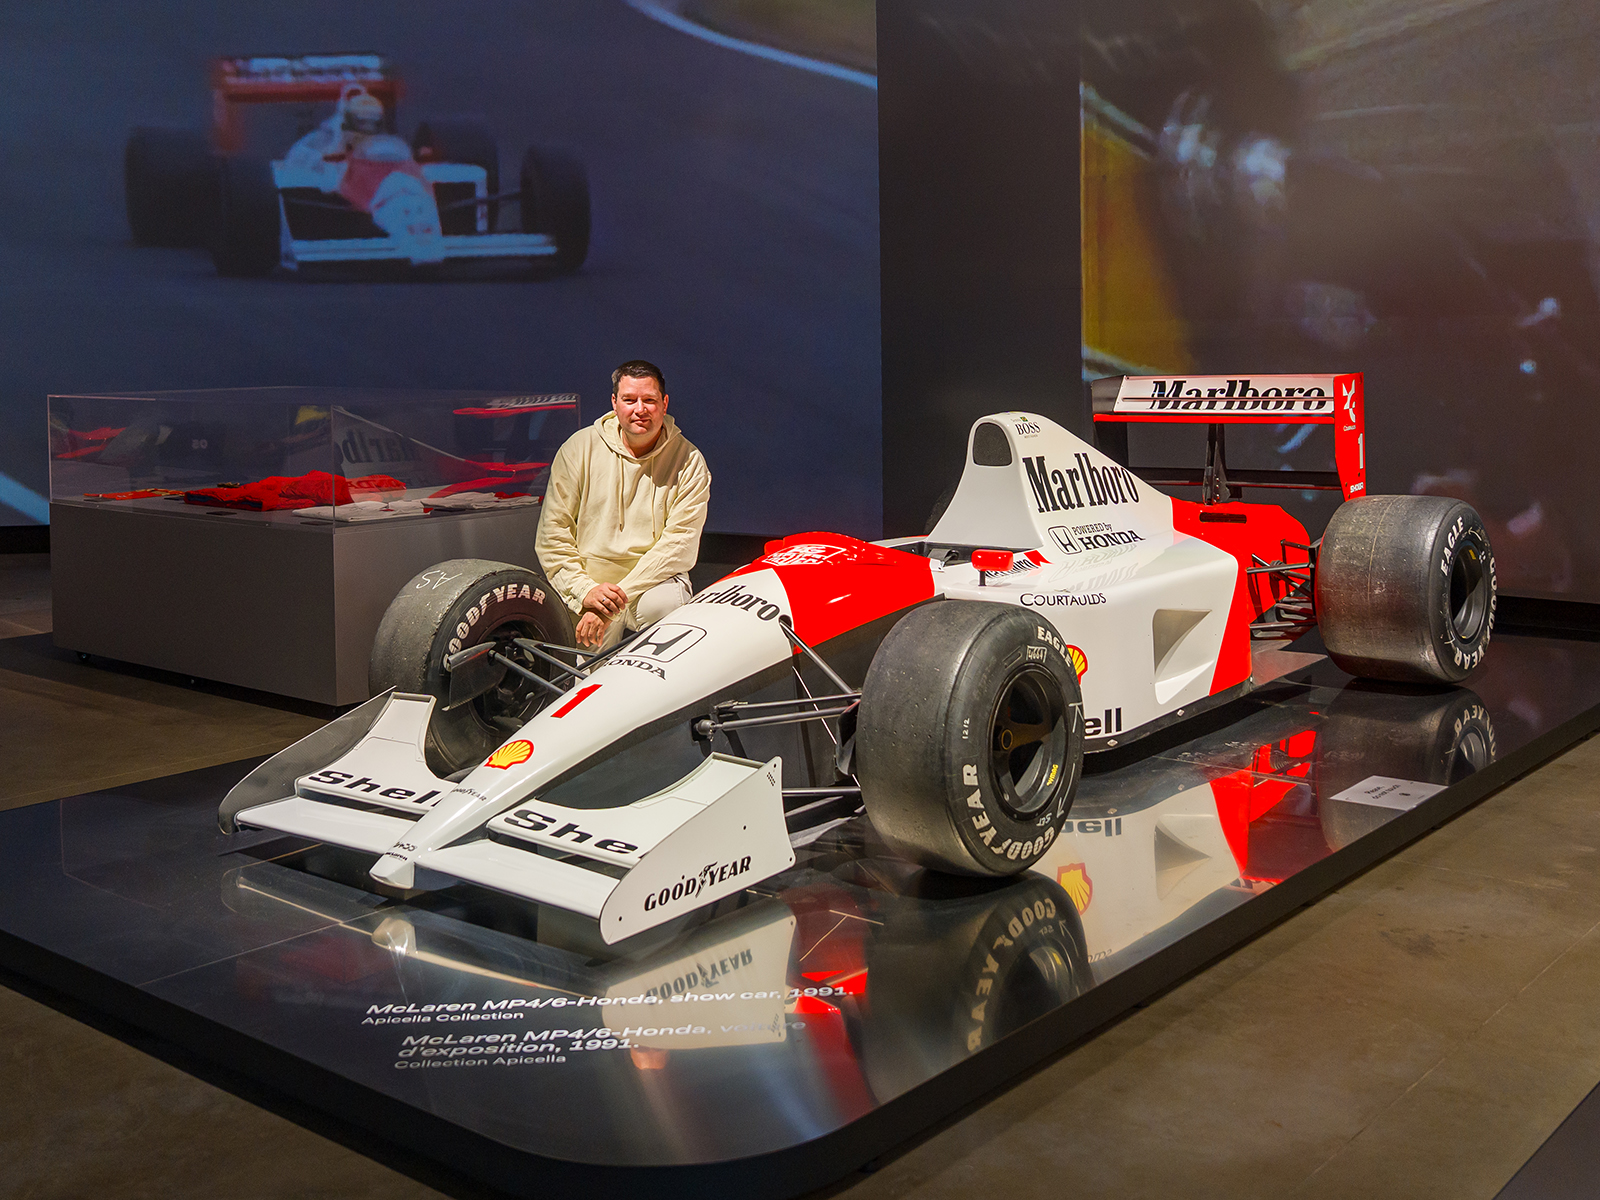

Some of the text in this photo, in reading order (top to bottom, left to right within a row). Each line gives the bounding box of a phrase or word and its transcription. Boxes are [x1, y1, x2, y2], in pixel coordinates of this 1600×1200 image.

[1149, 379, 1327, 411] Marlboro
[1015, 421, 1041, 435] BOSS
[1357, 433, 1364, 469] 1
[1022, 453, 1140, 513] Marlboro
[1072, 522, 1112, 536] POWERED by
[1078, 530, 1146, 551] HONDA
[1440, 516, 1464, 576] EAGLE
[690, 584, 781, 621] arlboro
[1020, 592, 1107, 606] COURTAULDS
[1037, 626, 1073, 667] EAGLE
[605, 658, 666, 680] ONDA
[550, 684, 603, 718] 1
[1084, 707, 1122, 736] ell
[504, 809, 643, 859] She
[366, 1001, 477, 1014] McLaren
[482, 993, 664, 1010] MP4/6-Honda,
[670, 991, 736, 1003] show
[789, 986, 853, 998] 1991.
[361, 1010, 524, 1025] Apicella Collection
[398, 1038, 638, 1058] d'exposition, 1991.
[401, 1033, 517, 1046] McLaren
[523, 1023, 711, 1042] MP4/6-Honda,
[394, 1054, 566, 1069] Collection Apicella
